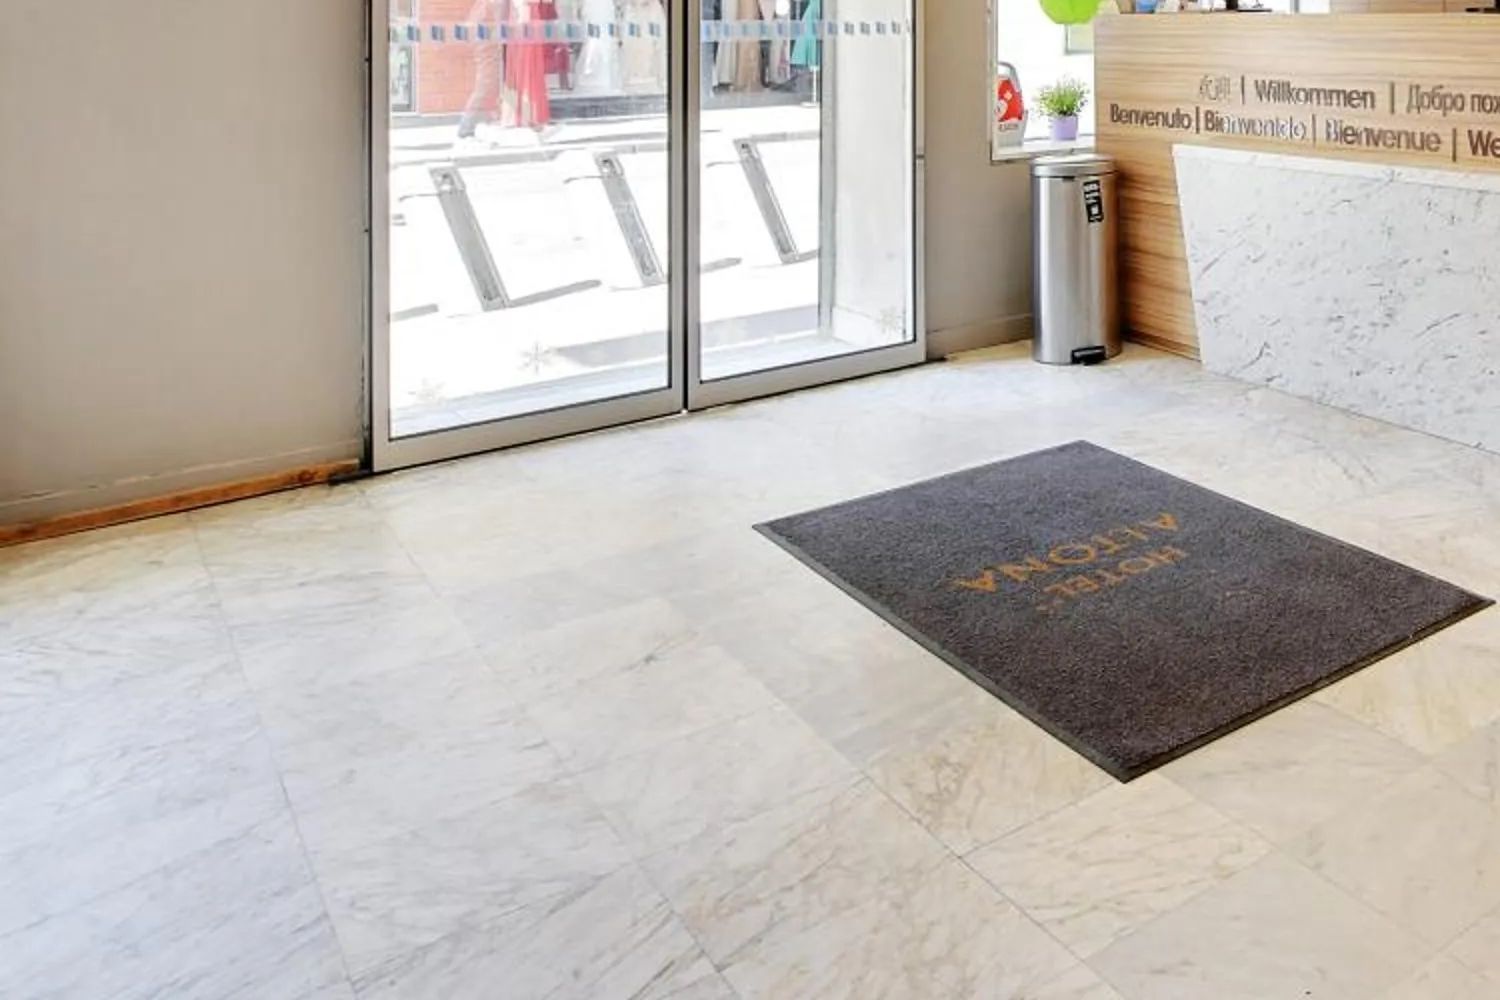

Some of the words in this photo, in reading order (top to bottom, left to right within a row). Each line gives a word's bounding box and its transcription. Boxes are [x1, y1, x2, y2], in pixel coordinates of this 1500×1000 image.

[1254, 78, 1375, 109] Willkommen
[1406, 83, 1465, 117] Добро
[1110, 102, 1191, 130] Benvenuto
[1325, 118, 1441, 153] Bienvenue
